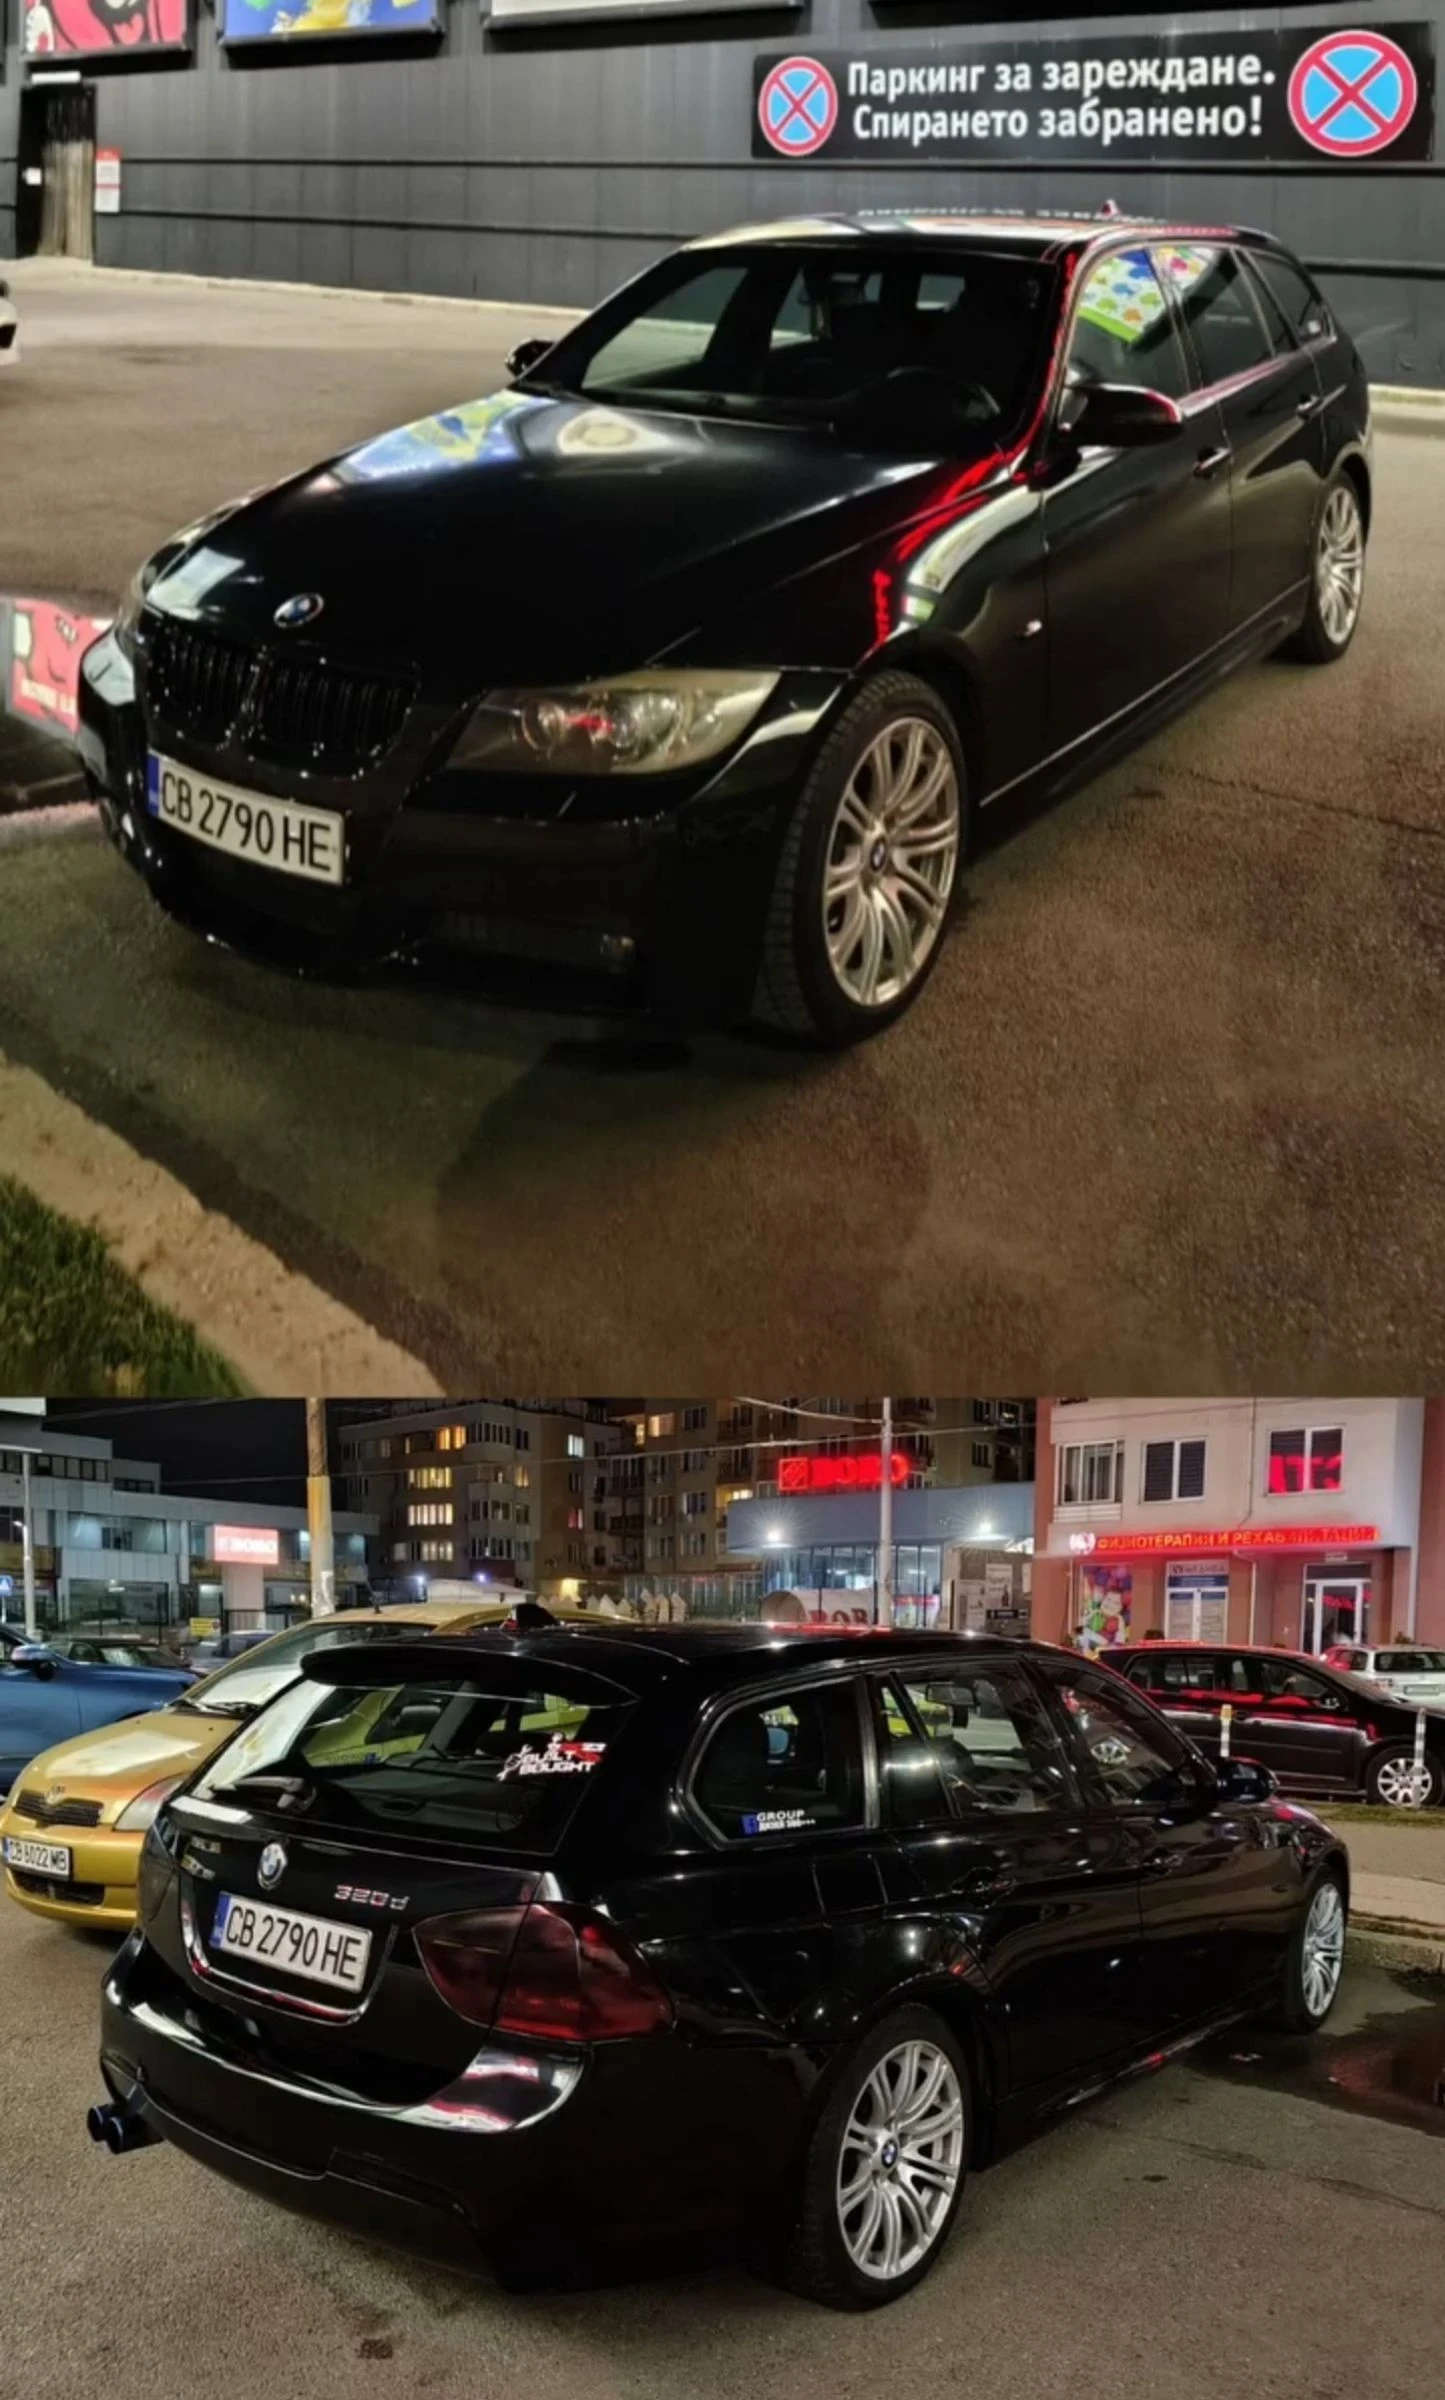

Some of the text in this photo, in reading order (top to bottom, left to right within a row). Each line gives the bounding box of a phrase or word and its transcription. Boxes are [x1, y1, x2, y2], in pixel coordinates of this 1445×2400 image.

[848, 54, 1276, 103] Паркинг за зареждане.
[853, 95, 1262, 147] Спирането забранено!
[162, 771, 332, 871] CB 2790 HE
[756, 1809, 805, 1822] GROUP
[334, 1885, 410, 1910] 320d
[226, 1906, 361, 1980] CB 2790 HE
